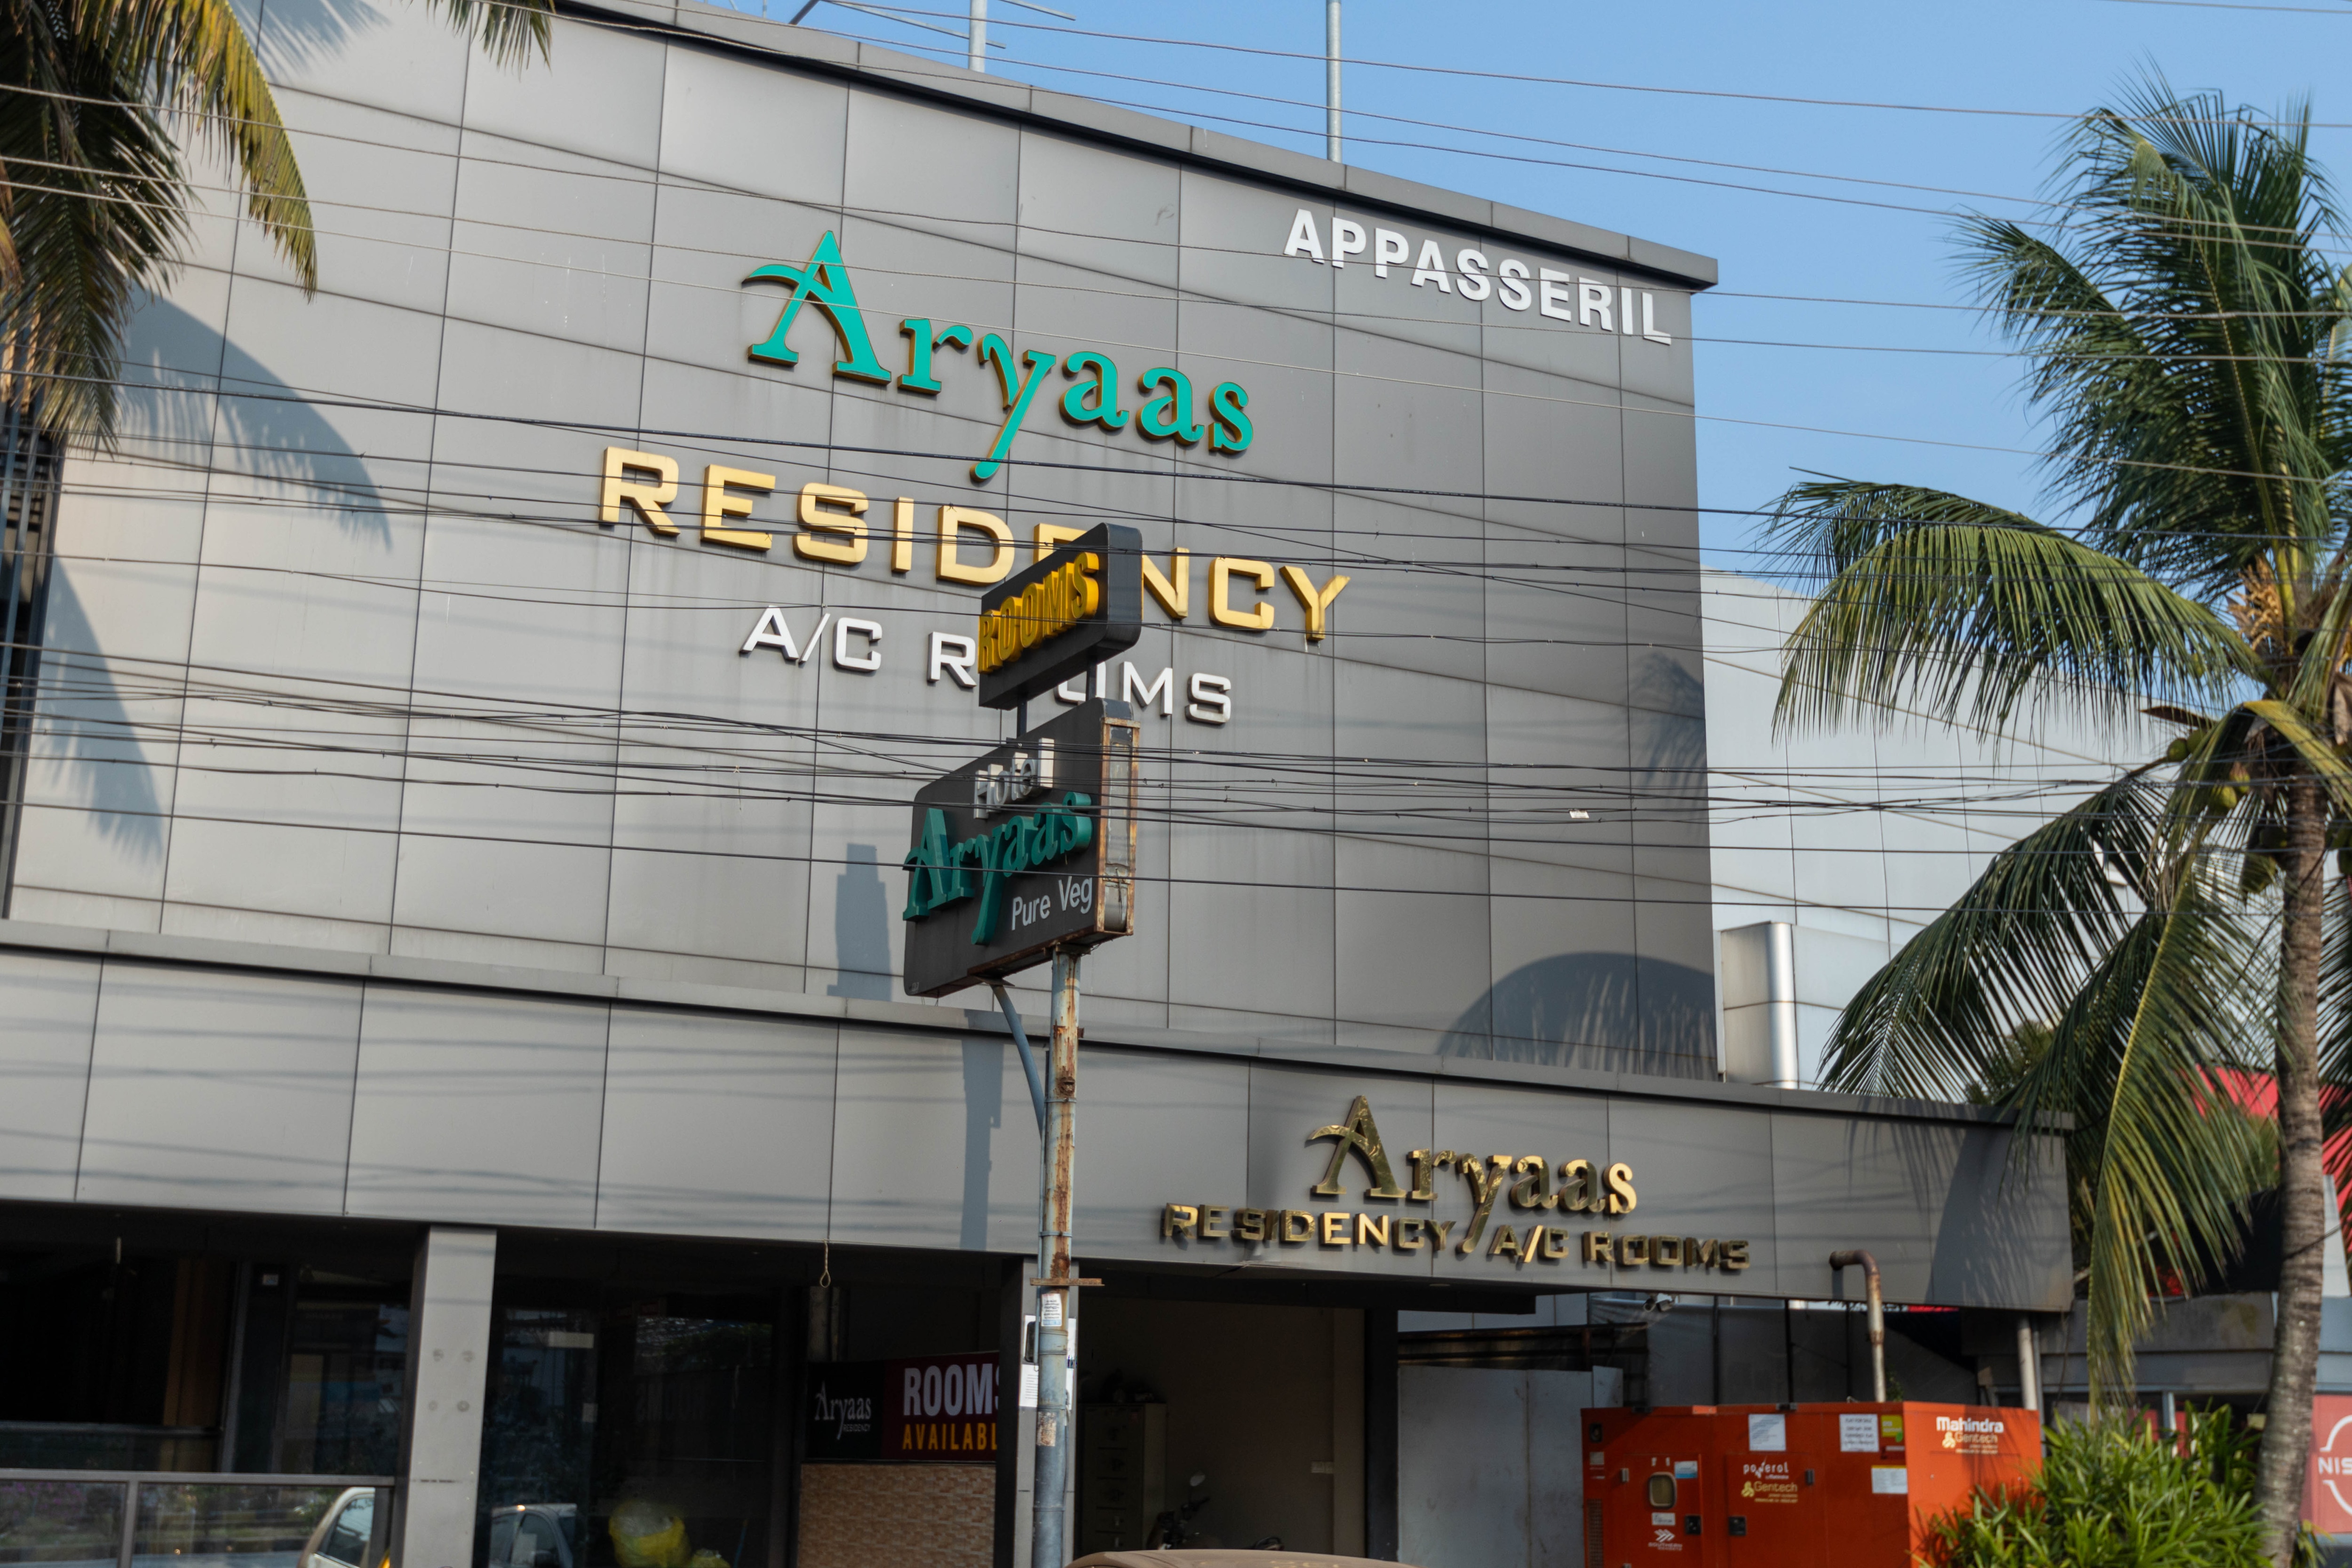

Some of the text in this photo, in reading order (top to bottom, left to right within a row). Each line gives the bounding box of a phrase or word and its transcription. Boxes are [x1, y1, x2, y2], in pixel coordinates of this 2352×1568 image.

[1283, 208, 1672, 345] APPASSERIL
[741, 230, 1253, 483] Aryaas
[978, 551, 1099, 674] ROOMS
[739, 604, 1232, 724] A/C RMS
[973, 738, 1054, 820] Hotel
[902, 791, 1092, 945] Aryaas
[1011, 875, 1093, 931] Pure Veg
[1306, 1095, 1638, 1253] Aryaas
[1162, 1202, 1456, 1252] RESIDENCY
[1583, 1231, 1751, 1270] ROOMS
[814, 1380, 872, 1441] Aryaas
[842, 1423, 871, 1433] RESIDENCY
[902, 1423, 997, 1450] AVAILABL
[1936, 1416, 2004, 1433] Mahindra
[1754, 1480, 1798, 1492] Gentech
